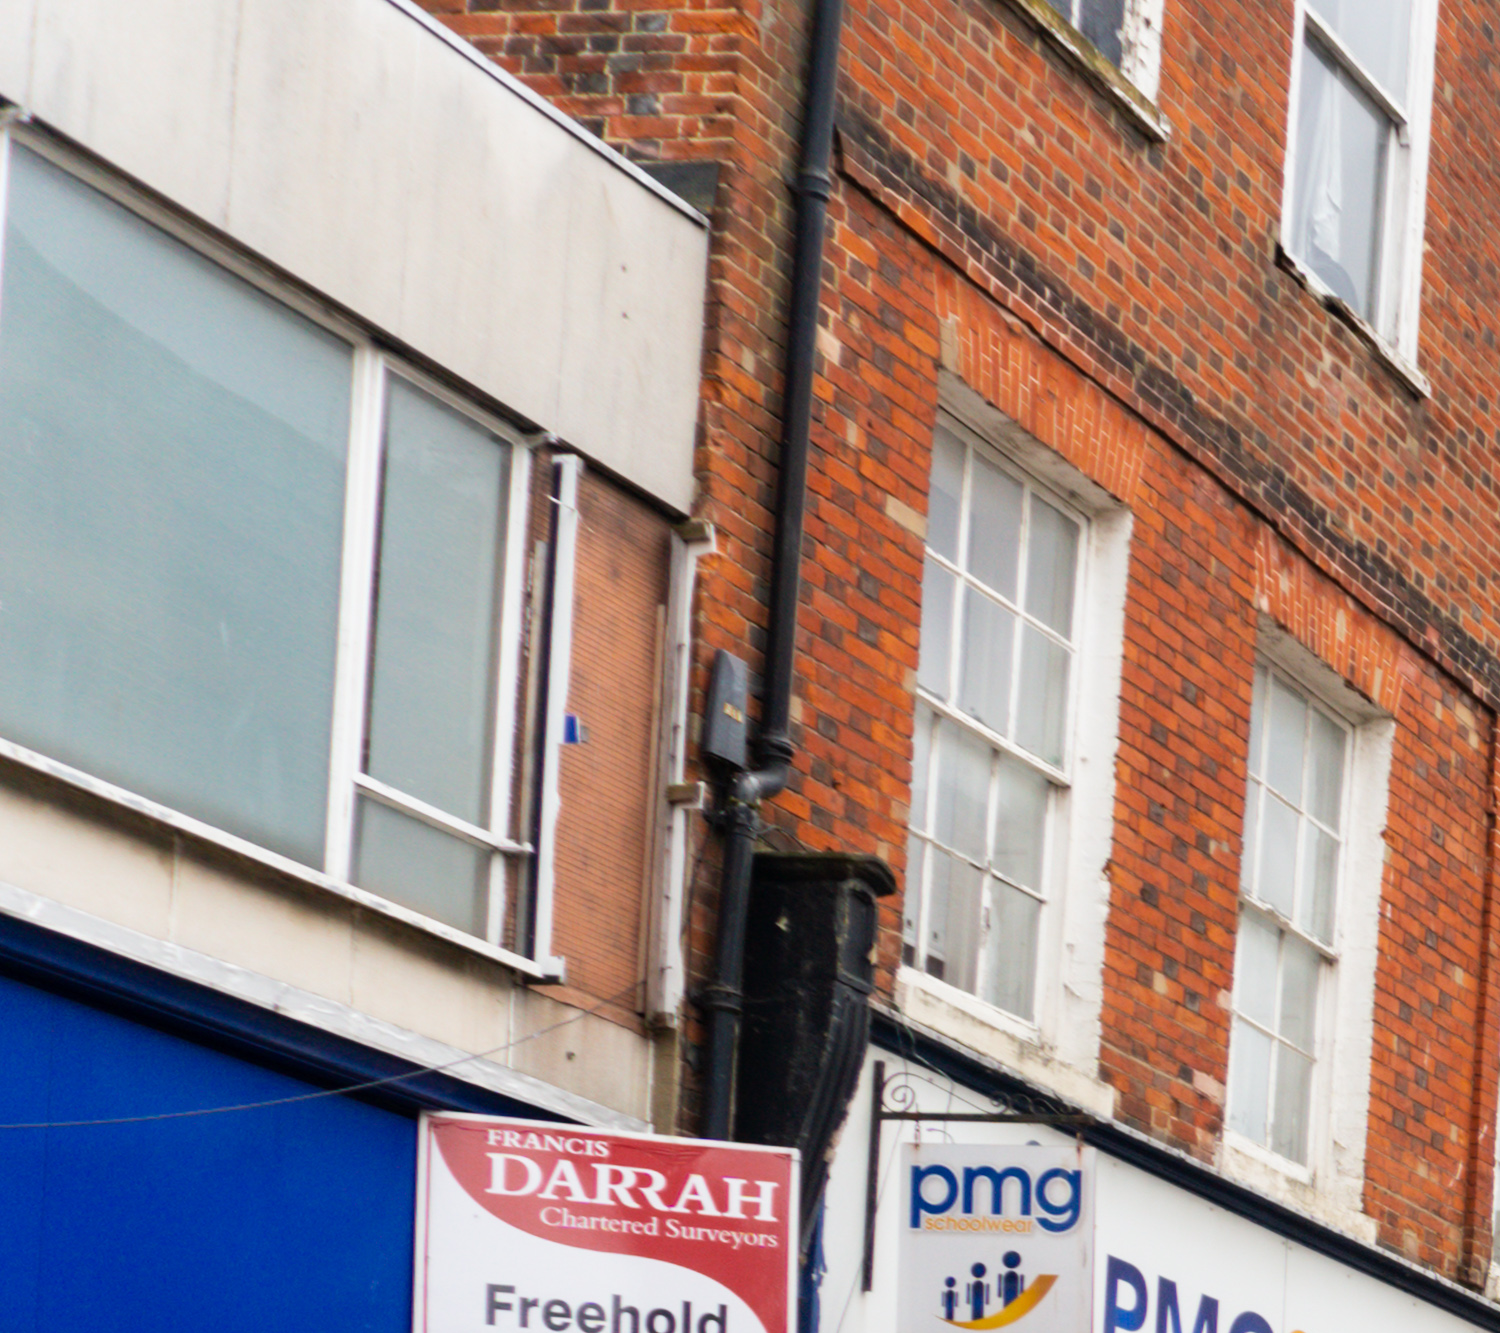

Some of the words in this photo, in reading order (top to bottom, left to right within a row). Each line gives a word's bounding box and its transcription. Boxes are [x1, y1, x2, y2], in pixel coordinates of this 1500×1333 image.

[487, 1129, 609, 1156] FRANCIS
[484, 1152, 779, 1222] DARRAH
[910, 1164, 1082, 1233] pmg
[539, 1207, 659, 1236] Chartered
[665, 1219, 778, 1249] Surveyors
[925, 1216, 1034, 1233] schoolwear
